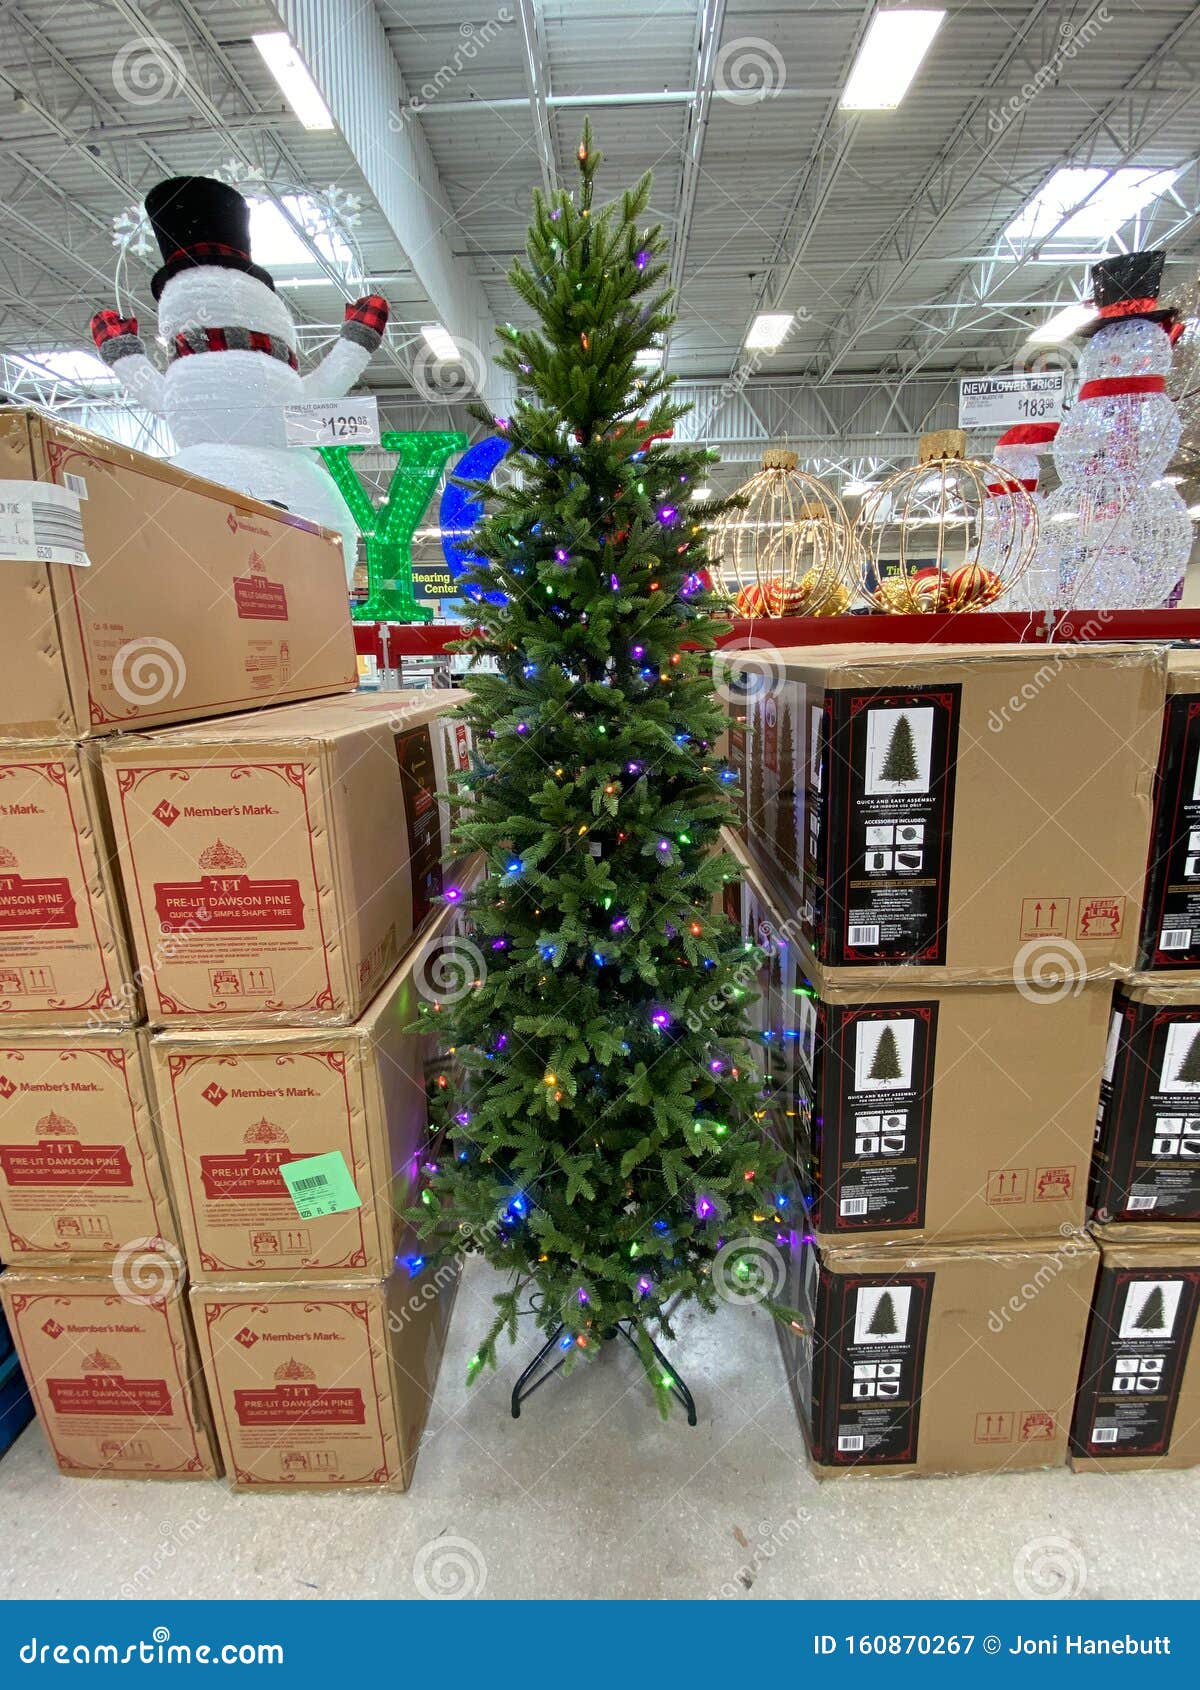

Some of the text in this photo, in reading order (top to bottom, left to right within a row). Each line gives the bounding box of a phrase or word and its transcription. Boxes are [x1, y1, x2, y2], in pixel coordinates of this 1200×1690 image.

[963, 378, 1061, 394] NEW LOWER PRICE
[412, 573, 450, 584] Hearing
[424, 580, 458, 593] Center
[10, 803, 38, 814] Mark
[184, 805, 241, 817] Member's
[210, 879, 240, 891] 7 FT
[38, 894, 63, 904] PINE
[166, 895, 291, 907] PRE-LIT DAWSON PINE
[273, 908, 293, 916] TREE
[19, 1082, 70, 1092] Member's
[231, 1088, 284, 1098] Member's
[47, 1144, 74, 1154] 7 FT
[10, 1157, 120, 1166] PRE-LIT DAWSON PINE
[254, 1152, 283, 1163] 7 FT
[211, 1168, 250, 1177] PRE-LIT
[67, 1324, 114, 1333] Member's
[262, 1332, 312, 1342] Member's
[92, 1390, 136, 1398] DAWSON
[138, 1390, 161, 1398] PINE
[284, 1387, 311, 1397] 7 FT
[244, 1399, 354, 1408] PRE-LIT DAWSON PINE
